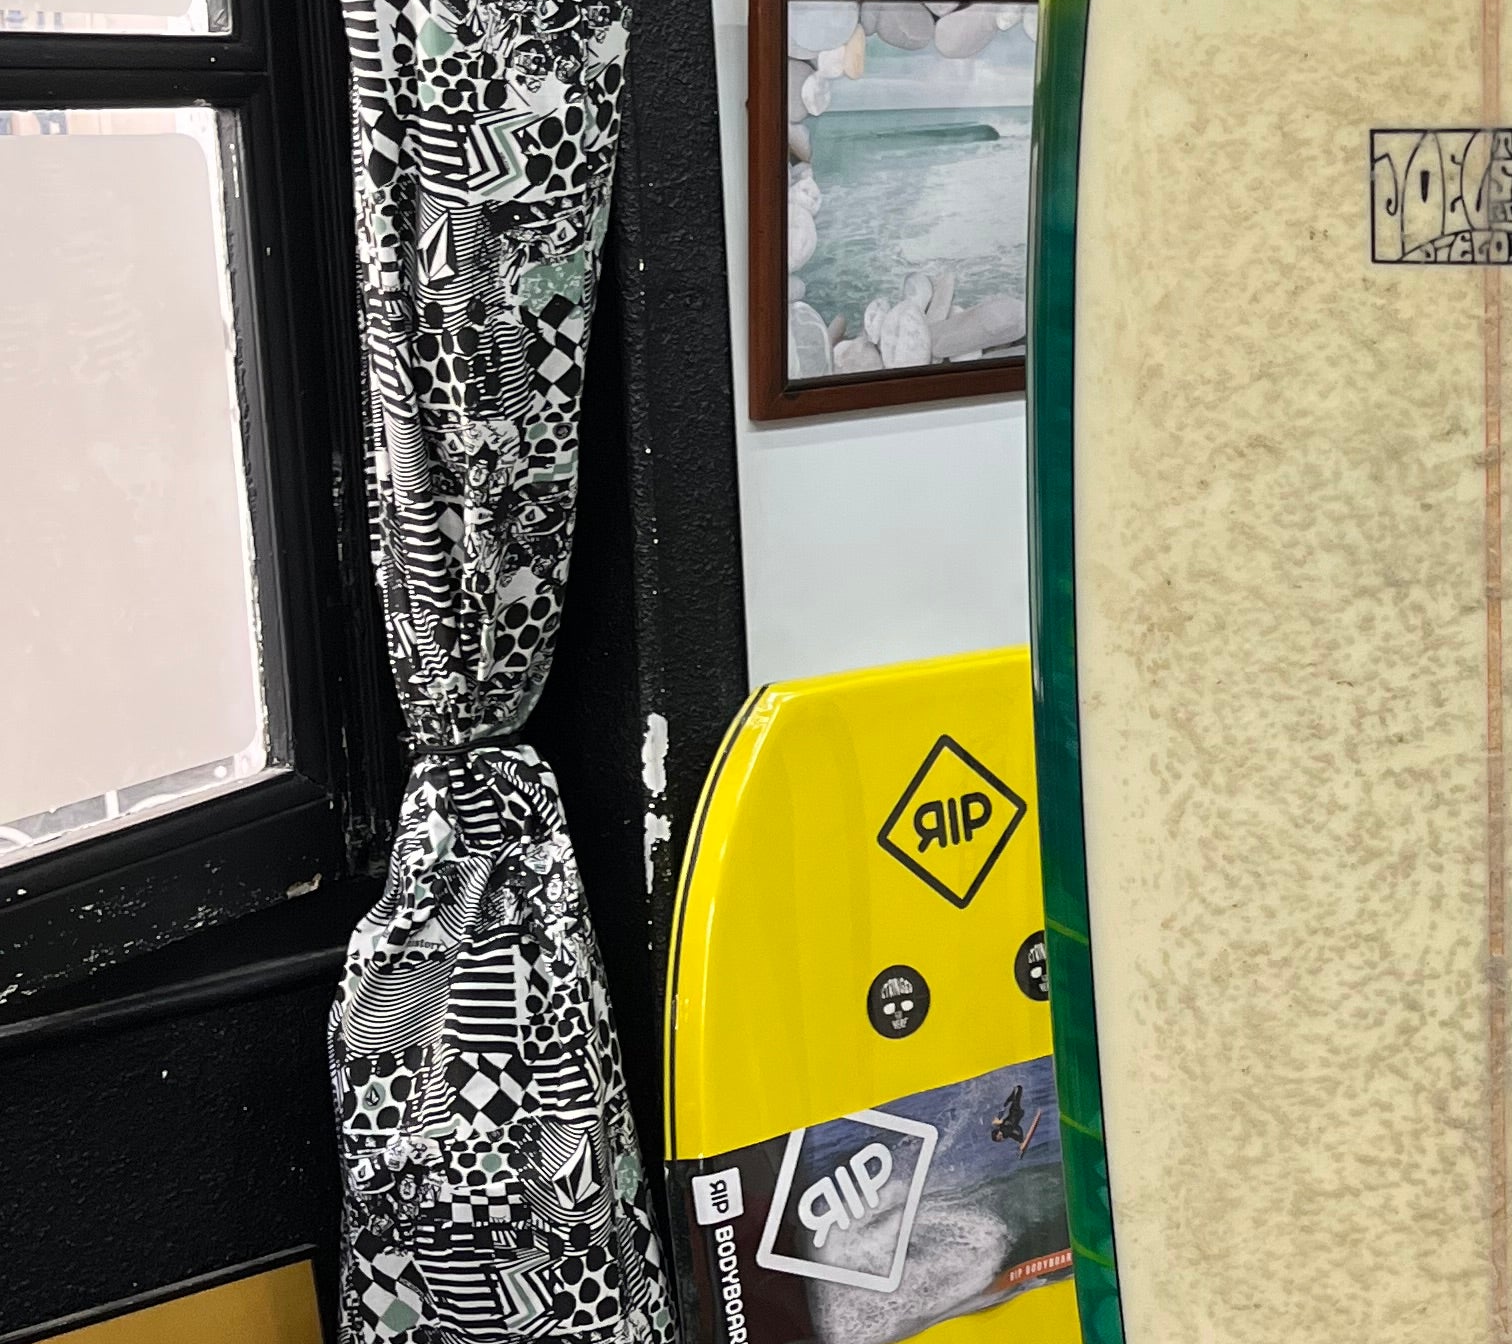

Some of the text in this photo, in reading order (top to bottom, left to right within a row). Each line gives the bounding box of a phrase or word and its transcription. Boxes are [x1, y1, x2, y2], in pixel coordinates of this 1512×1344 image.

[913, 792, 992, 853] RIP
[798, 1142, 893, 1248] RIP
[1025, 1252, 1072, 1276] BODYBOAR
